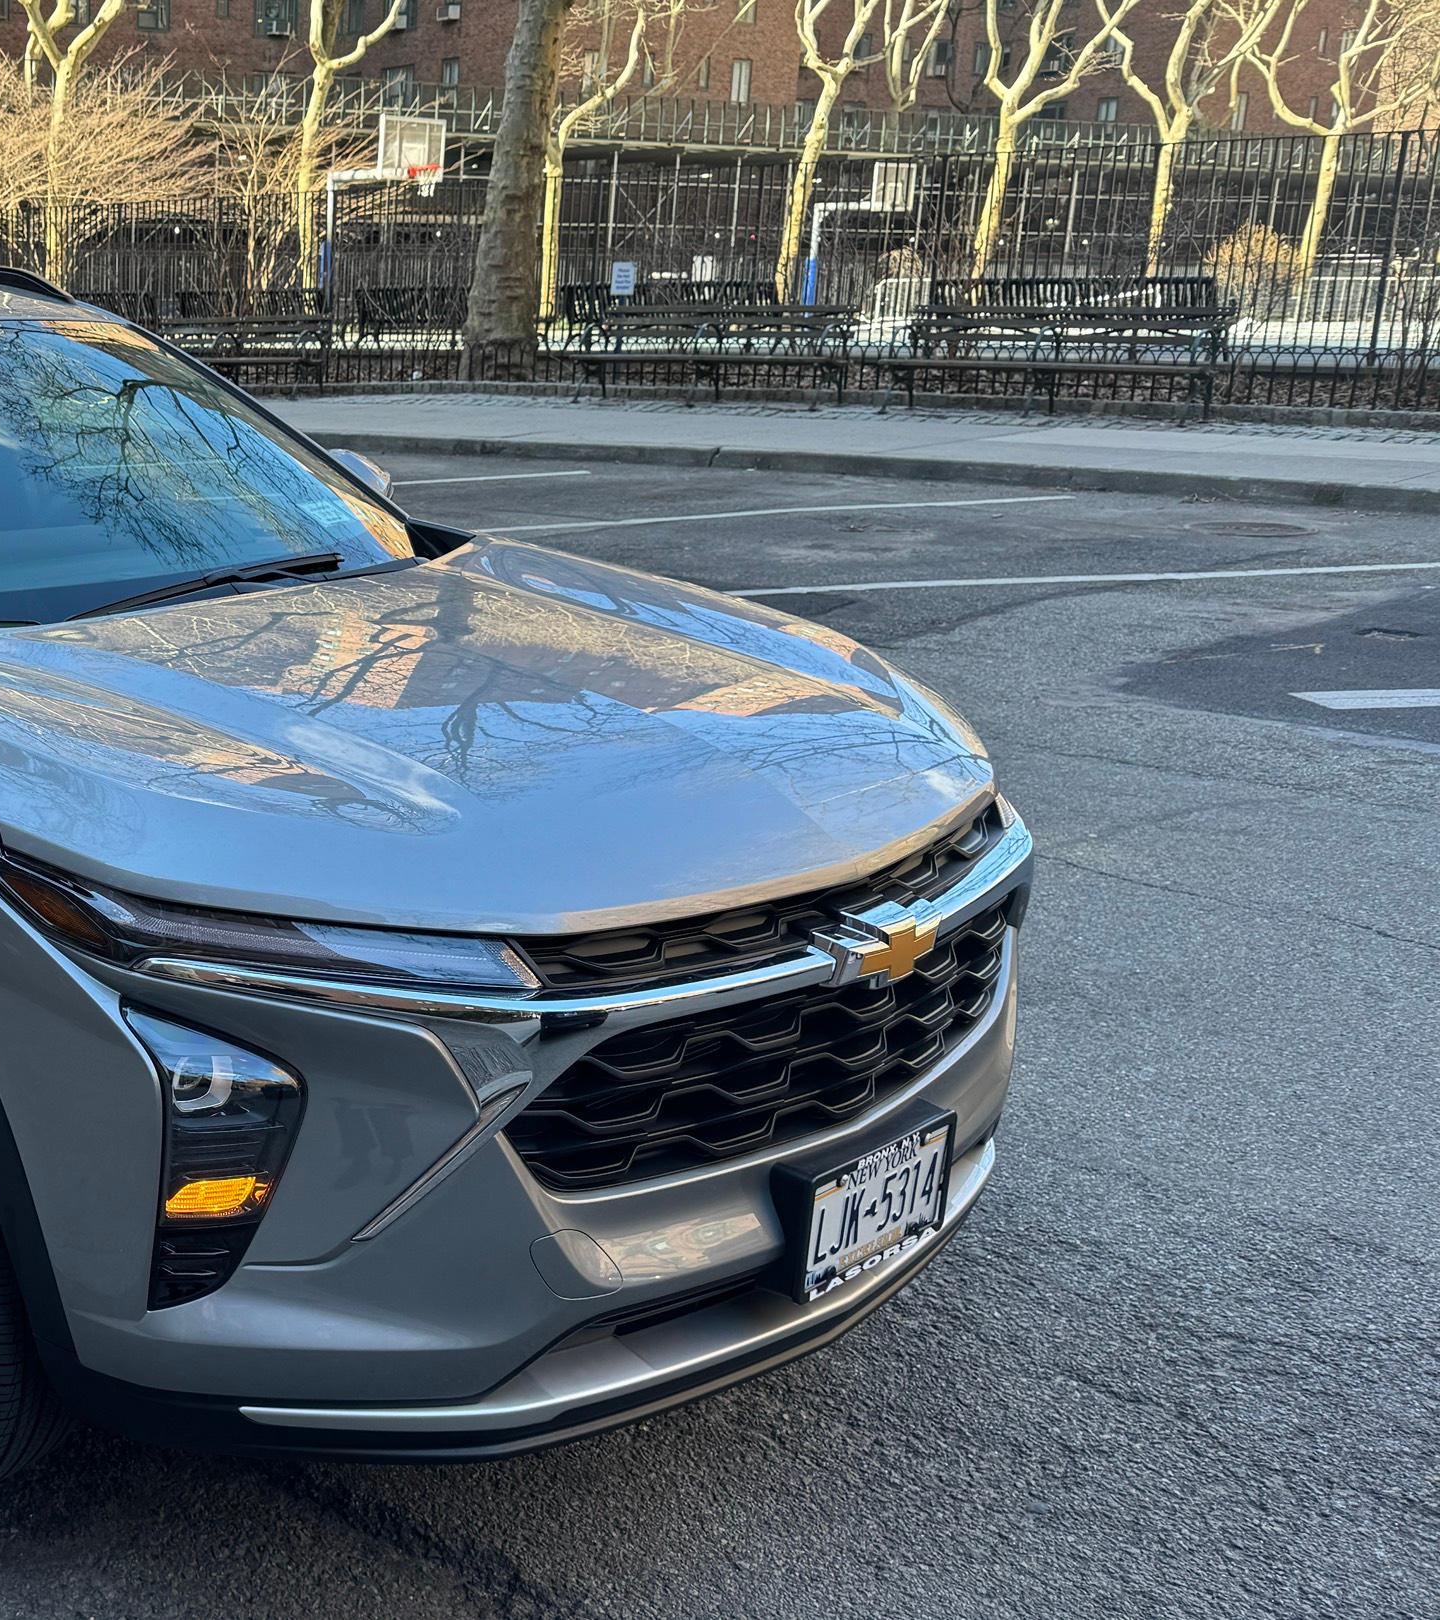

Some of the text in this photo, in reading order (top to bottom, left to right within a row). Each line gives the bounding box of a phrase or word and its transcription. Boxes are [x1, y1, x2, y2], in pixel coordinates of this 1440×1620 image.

[847, 1139, 917, 1190] NEW YORK
[814, 1189, 864, 1263] LJK
[875, 1150, 938, 1232] 5314
[809, 1226, 937, 1302] LASORSA
